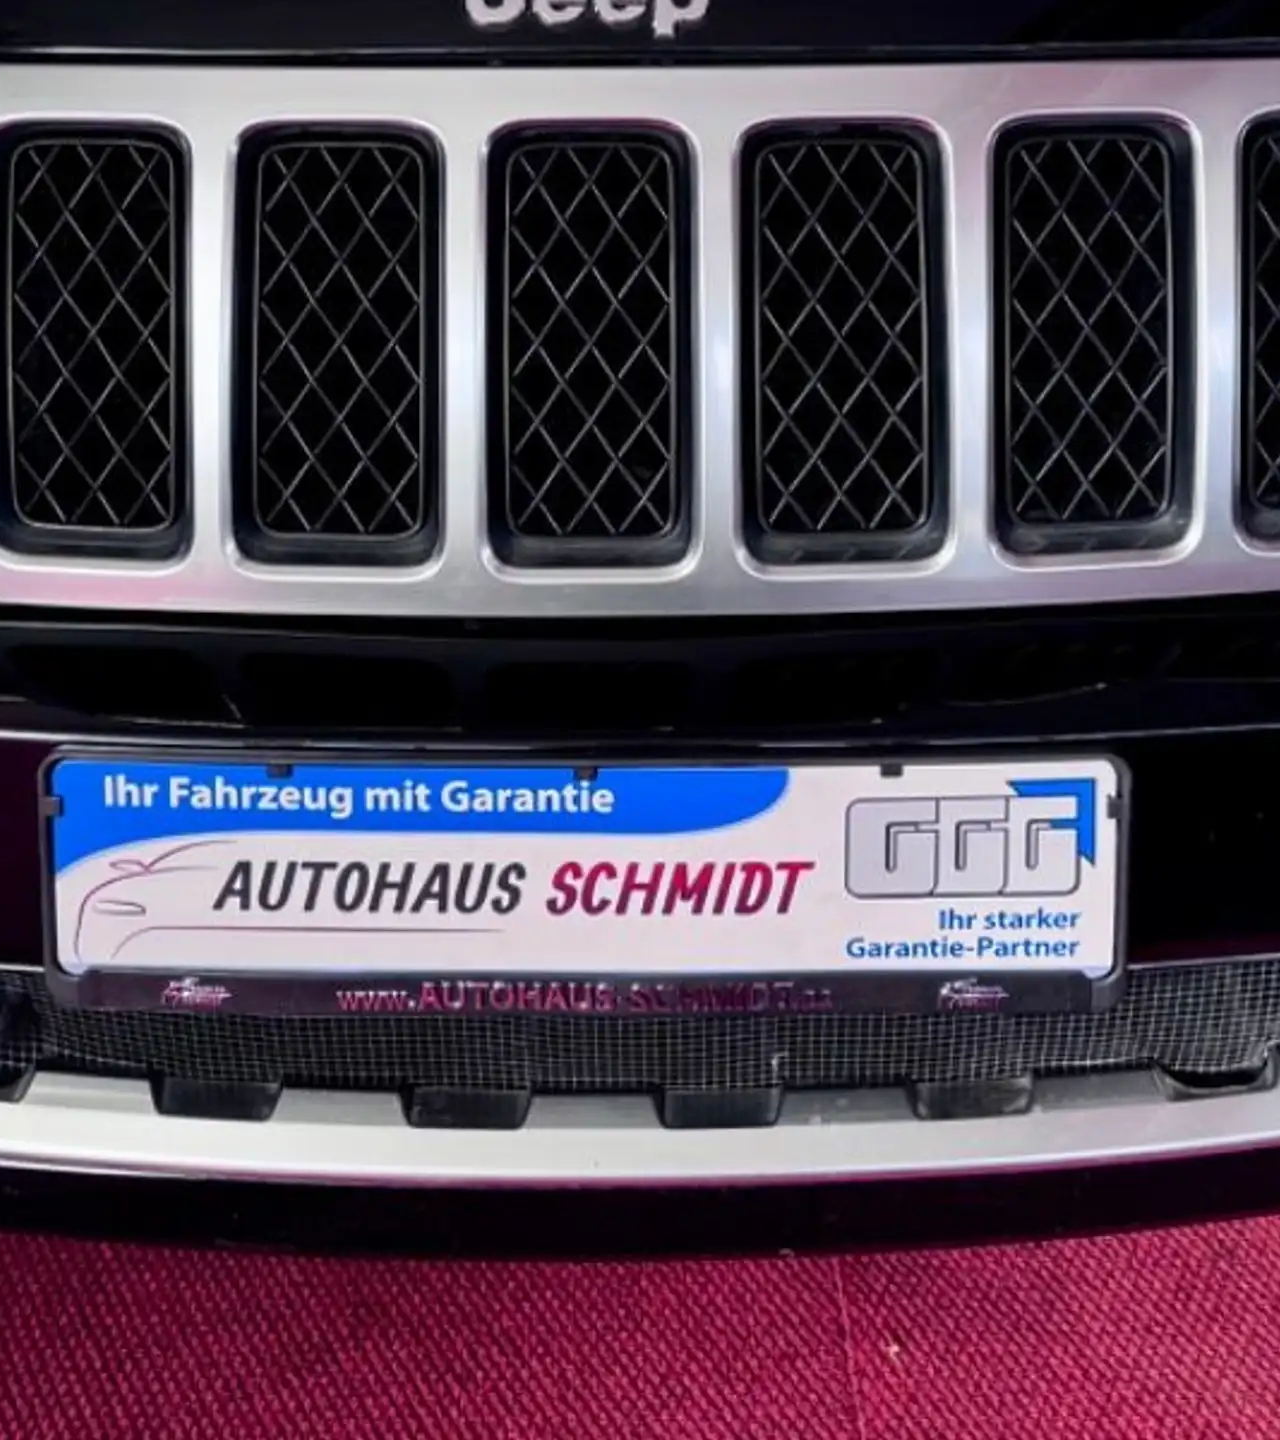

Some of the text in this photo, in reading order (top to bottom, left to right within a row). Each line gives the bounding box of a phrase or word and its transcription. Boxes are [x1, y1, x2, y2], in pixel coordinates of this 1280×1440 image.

[103, 774, 616, 820] Ihr Fahrzeug mit Garantie
[213, 859, 817, 916] AUTOHAUS SCHMIDT
[938, 906, 1082, 931] Ihr starker
[845, 935, 1081, 961] Garantie-Partner
